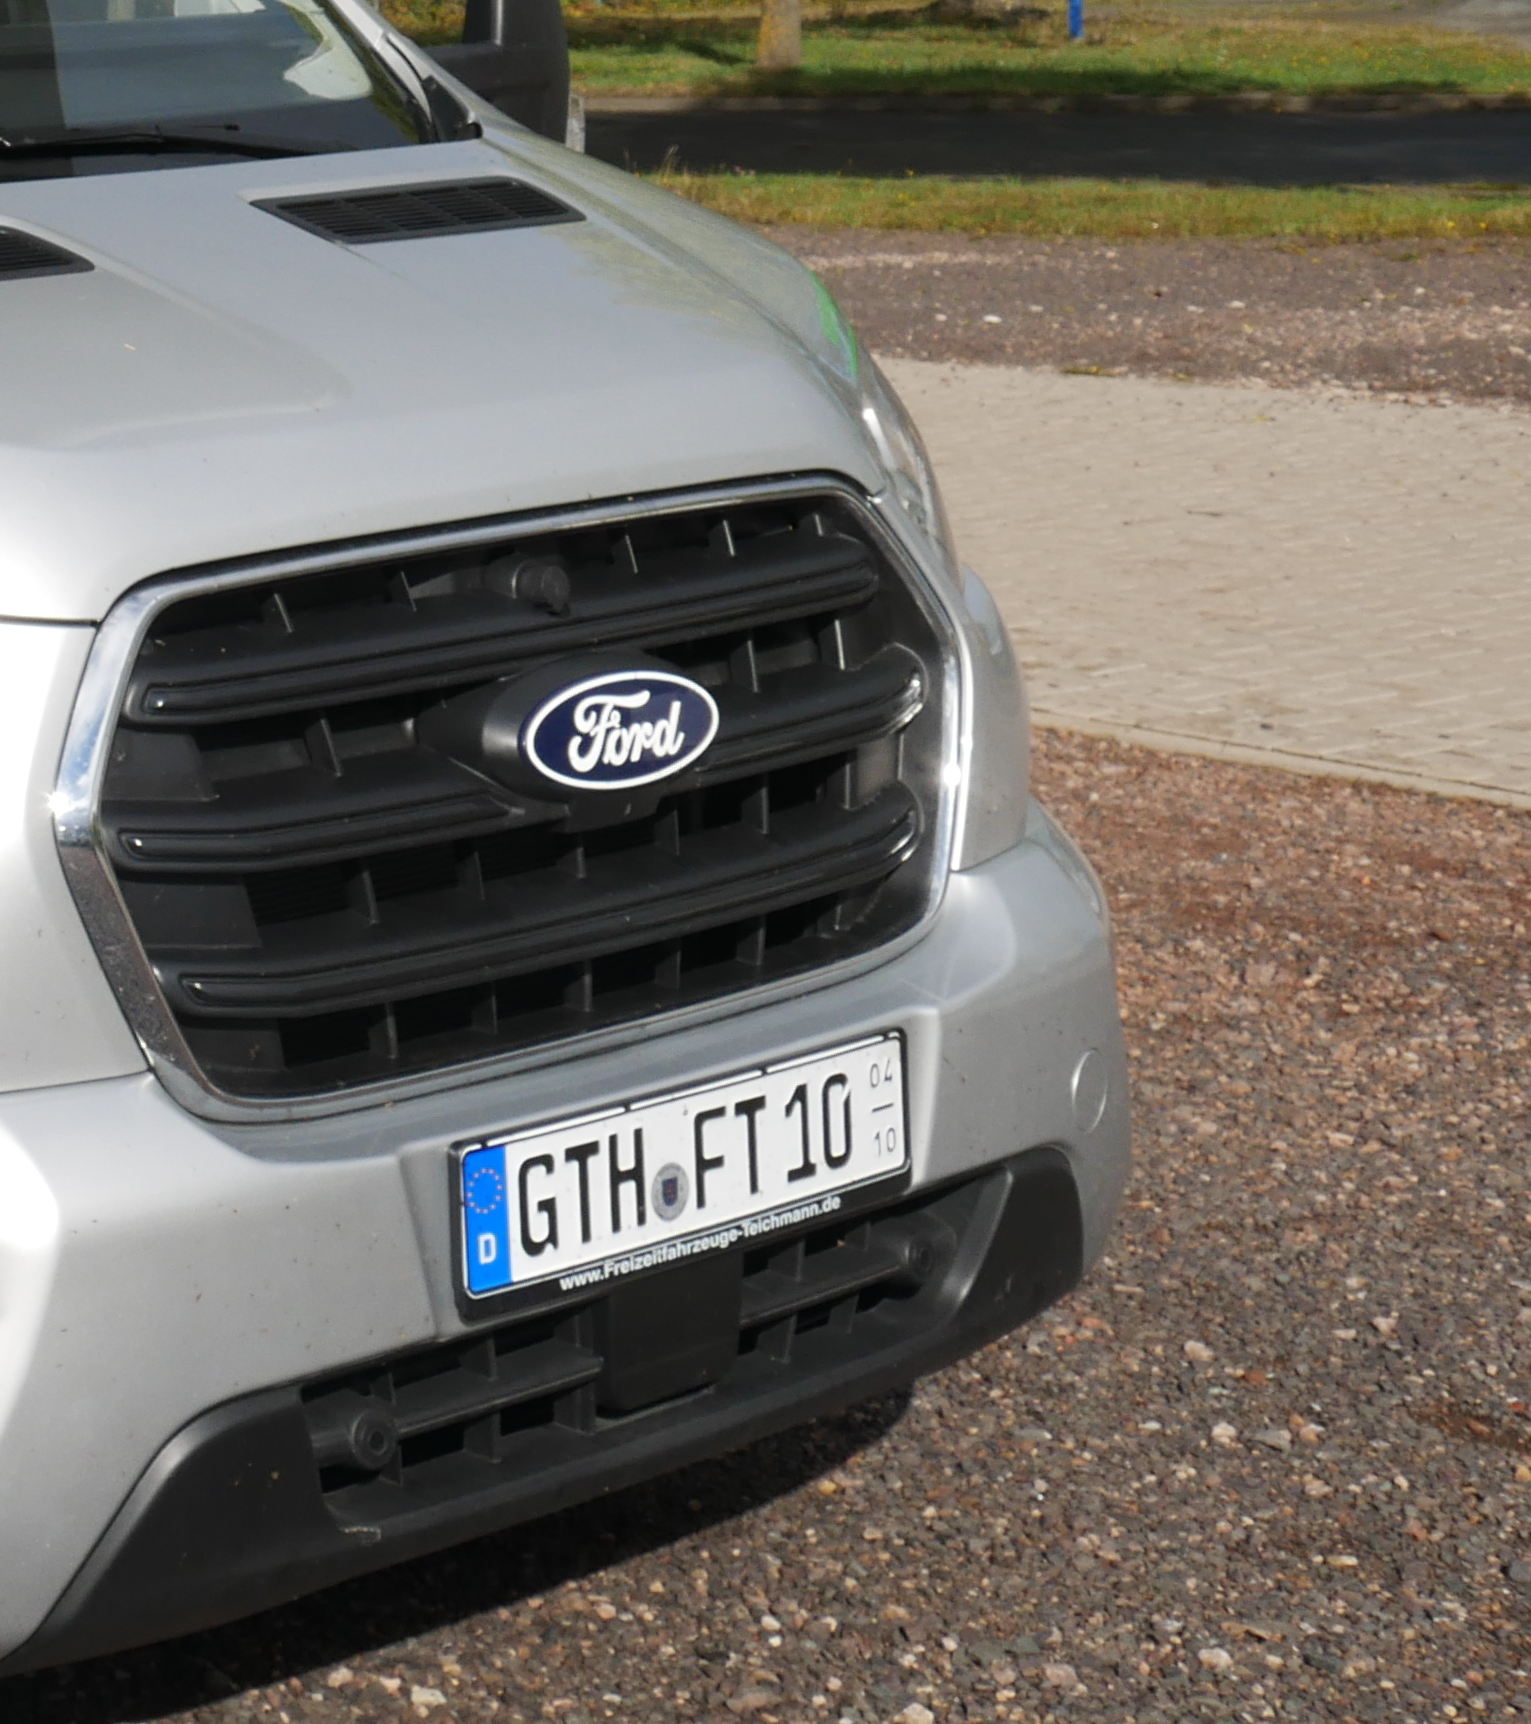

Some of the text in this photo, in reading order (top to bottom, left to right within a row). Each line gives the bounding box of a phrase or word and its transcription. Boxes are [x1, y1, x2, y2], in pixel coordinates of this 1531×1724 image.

[567, 689, 685, 773] Ford
[517, 1127, 648, 1258] GTH
[477, 1232, 497, 1265] D
[559, 1195, 842, 1292] www.Freizeitfahrzeuge-Teichmann.de
